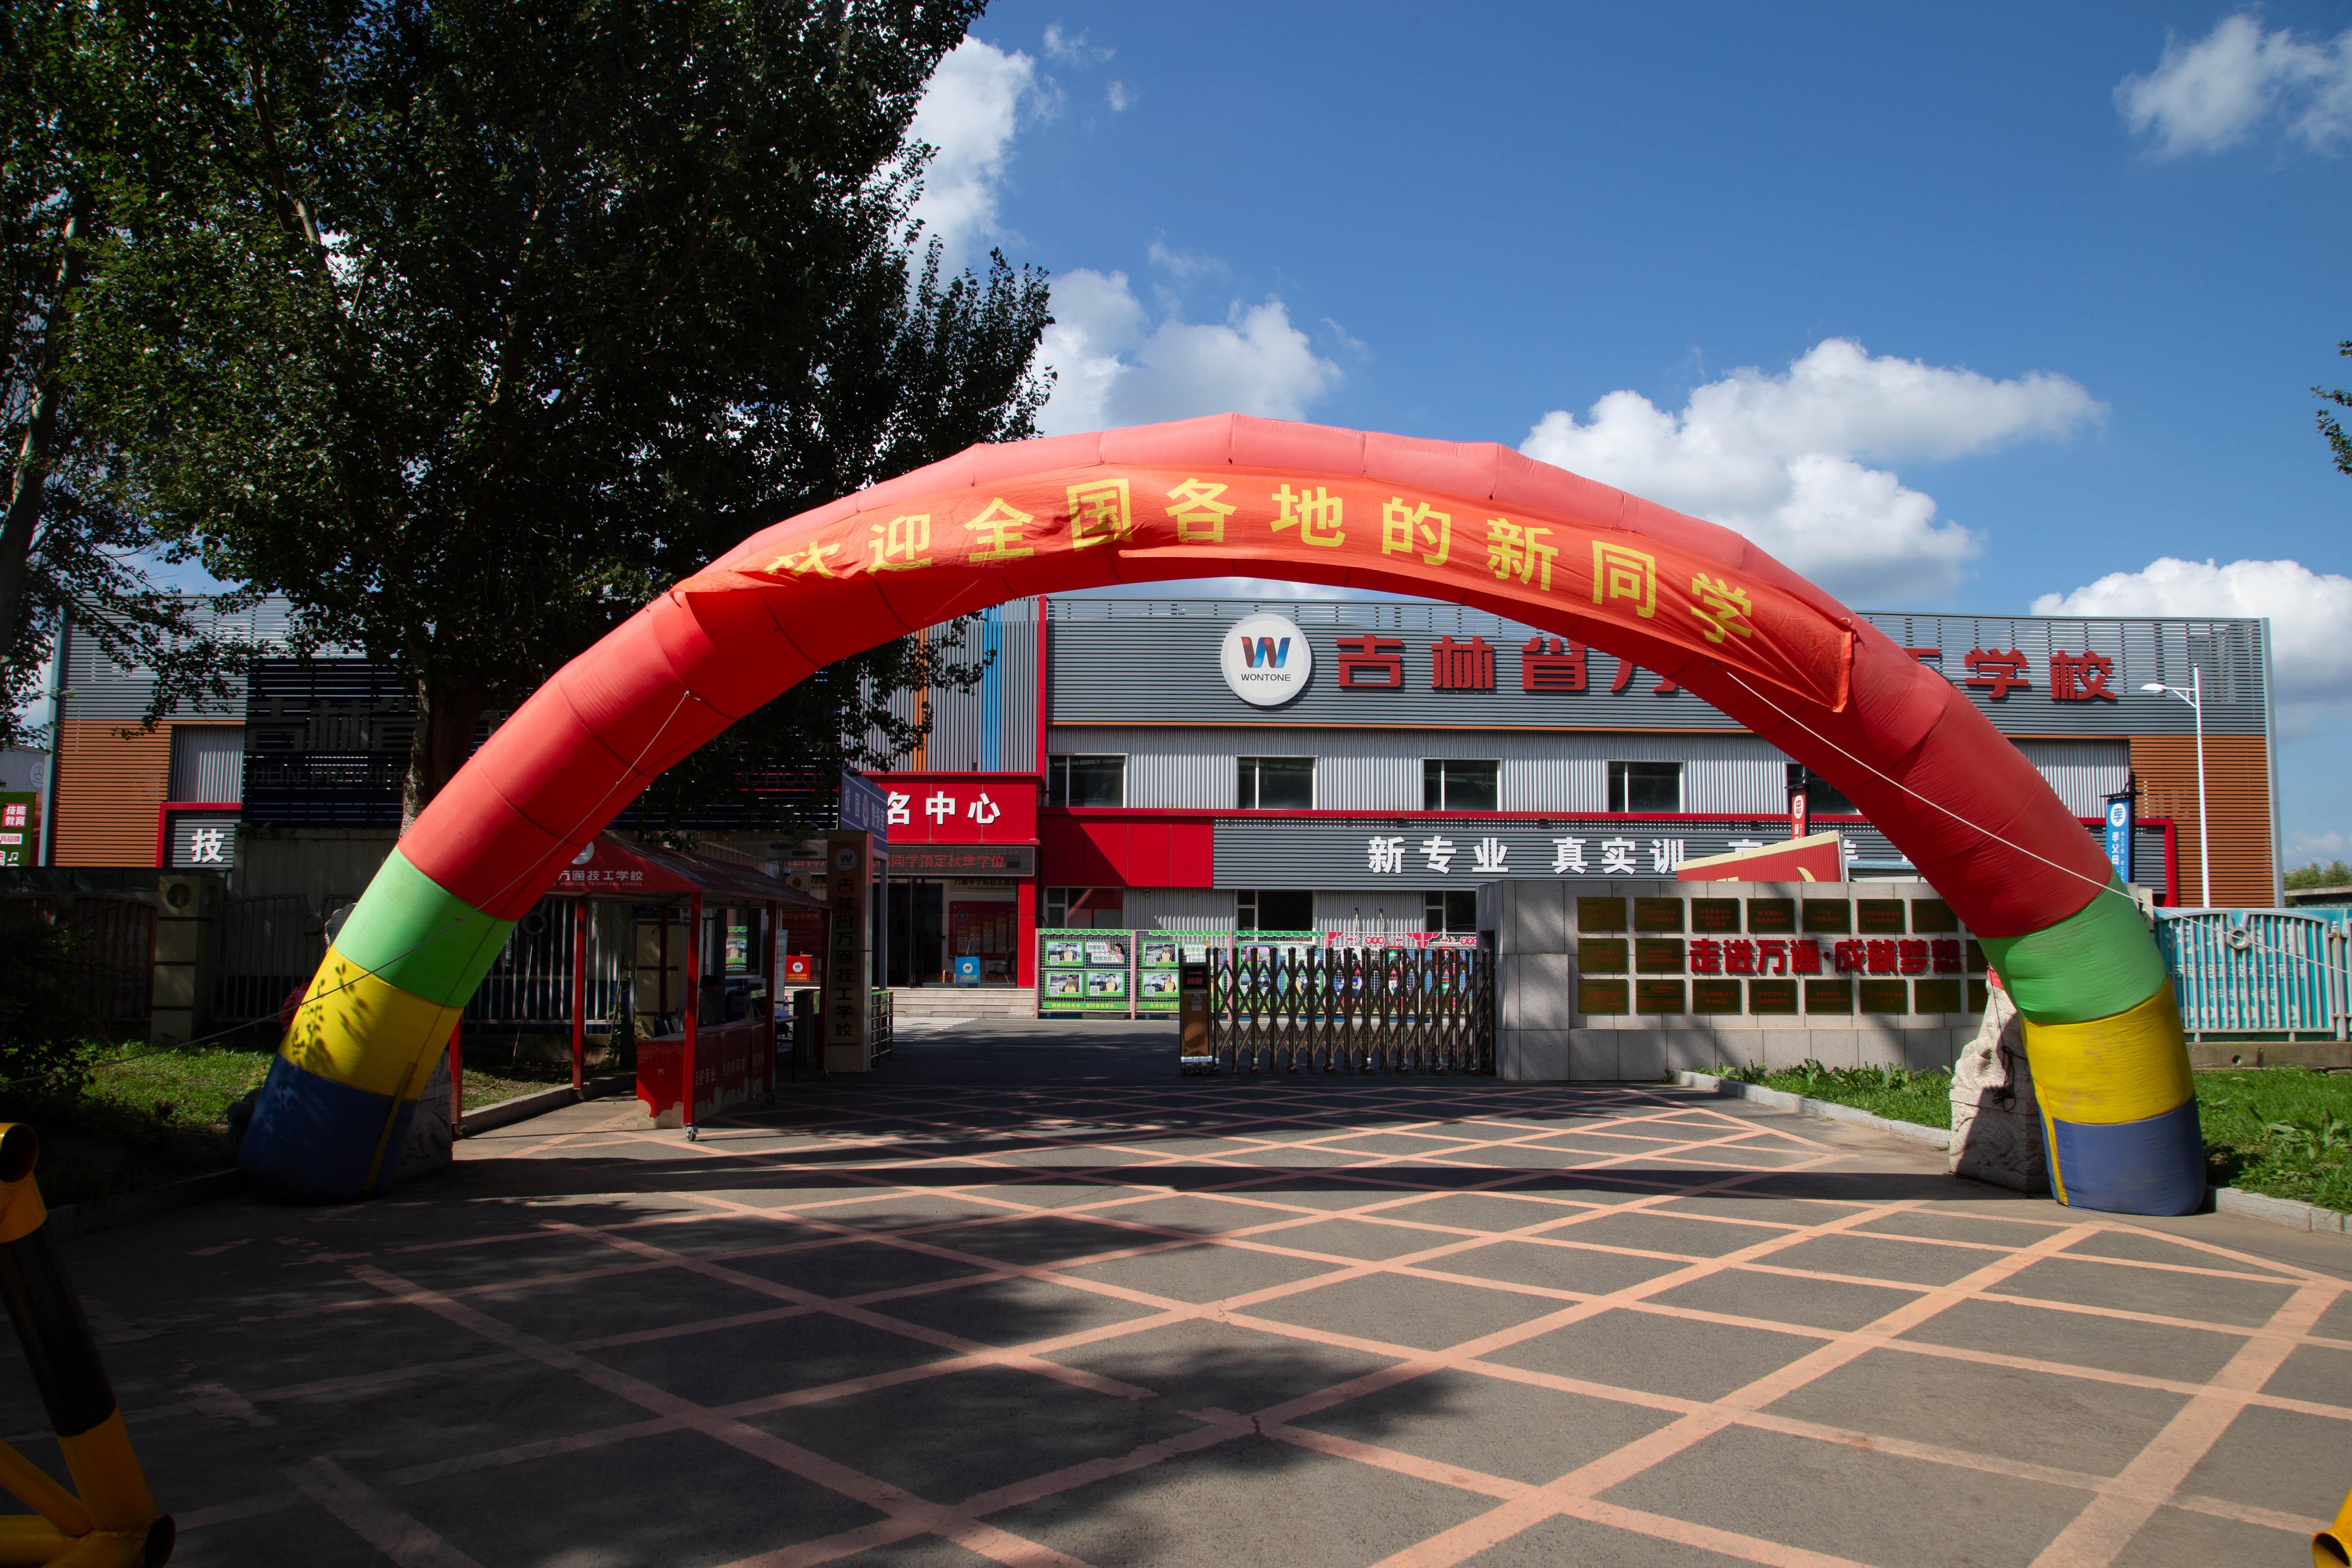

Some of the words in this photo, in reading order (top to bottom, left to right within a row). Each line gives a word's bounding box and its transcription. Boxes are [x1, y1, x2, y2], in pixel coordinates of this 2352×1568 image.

[5, 816, 25, 826] 教育
[6, 805, 26, 815] 技能
[887, 791, 1001, 825] 名中心
[192, 829, 225, 863] 技
[887, 854, 1004, 869] 同学预定秋季学位
[1367, 835, 1509, 875] 新专业
[1552, 836, 1684, 875] 真实训
[557, 870, 643, 881] 万通技工学校
[835, 878, 854, 1037] 吉林省万通技工学校
[1690, 938, 1962, 973] 走进万通·成就梦想
